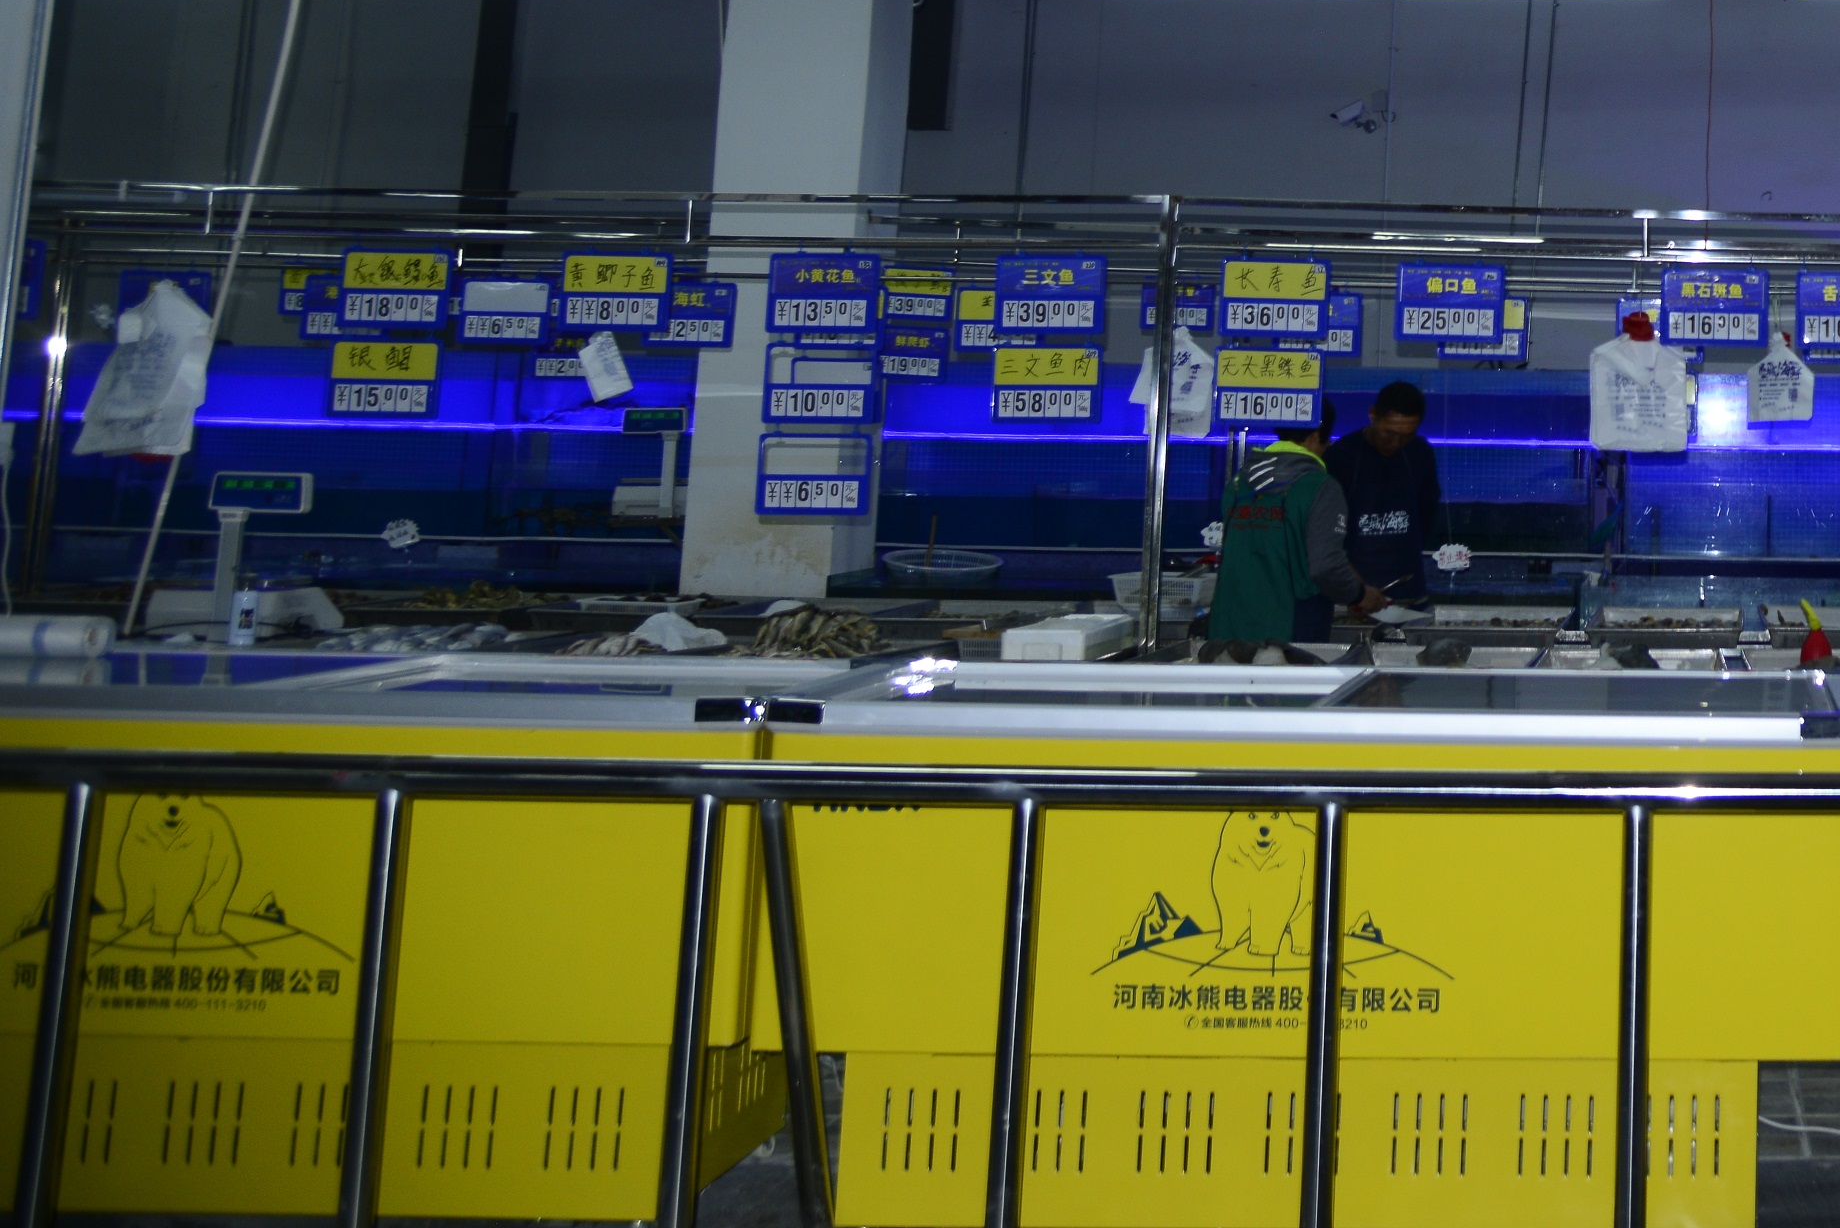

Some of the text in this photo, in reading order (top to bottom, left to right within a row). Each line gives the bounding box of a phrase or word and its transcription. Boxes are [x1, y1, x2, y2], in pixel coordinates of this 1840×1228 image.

[795, 268, 856, 285] 小黄花鱼
[1023, 268, 1076, 286] 三文鱼
[1235, 265, 1323, 296] 长寿鱼
[1426, 277, 1479, 295] 偏口鱼
[1681, 282, 1744, 299] 黑石斑鱼
[1000, 352, 1092, 378] 三文鱼肉
[13, 962, 341, 995] 河熊电器股份有限公司
[1113, 983, 1441, 1014] 河南冰熊电器股有限公司
[1201, 1017, 1272, 1030] 全国客服热线
